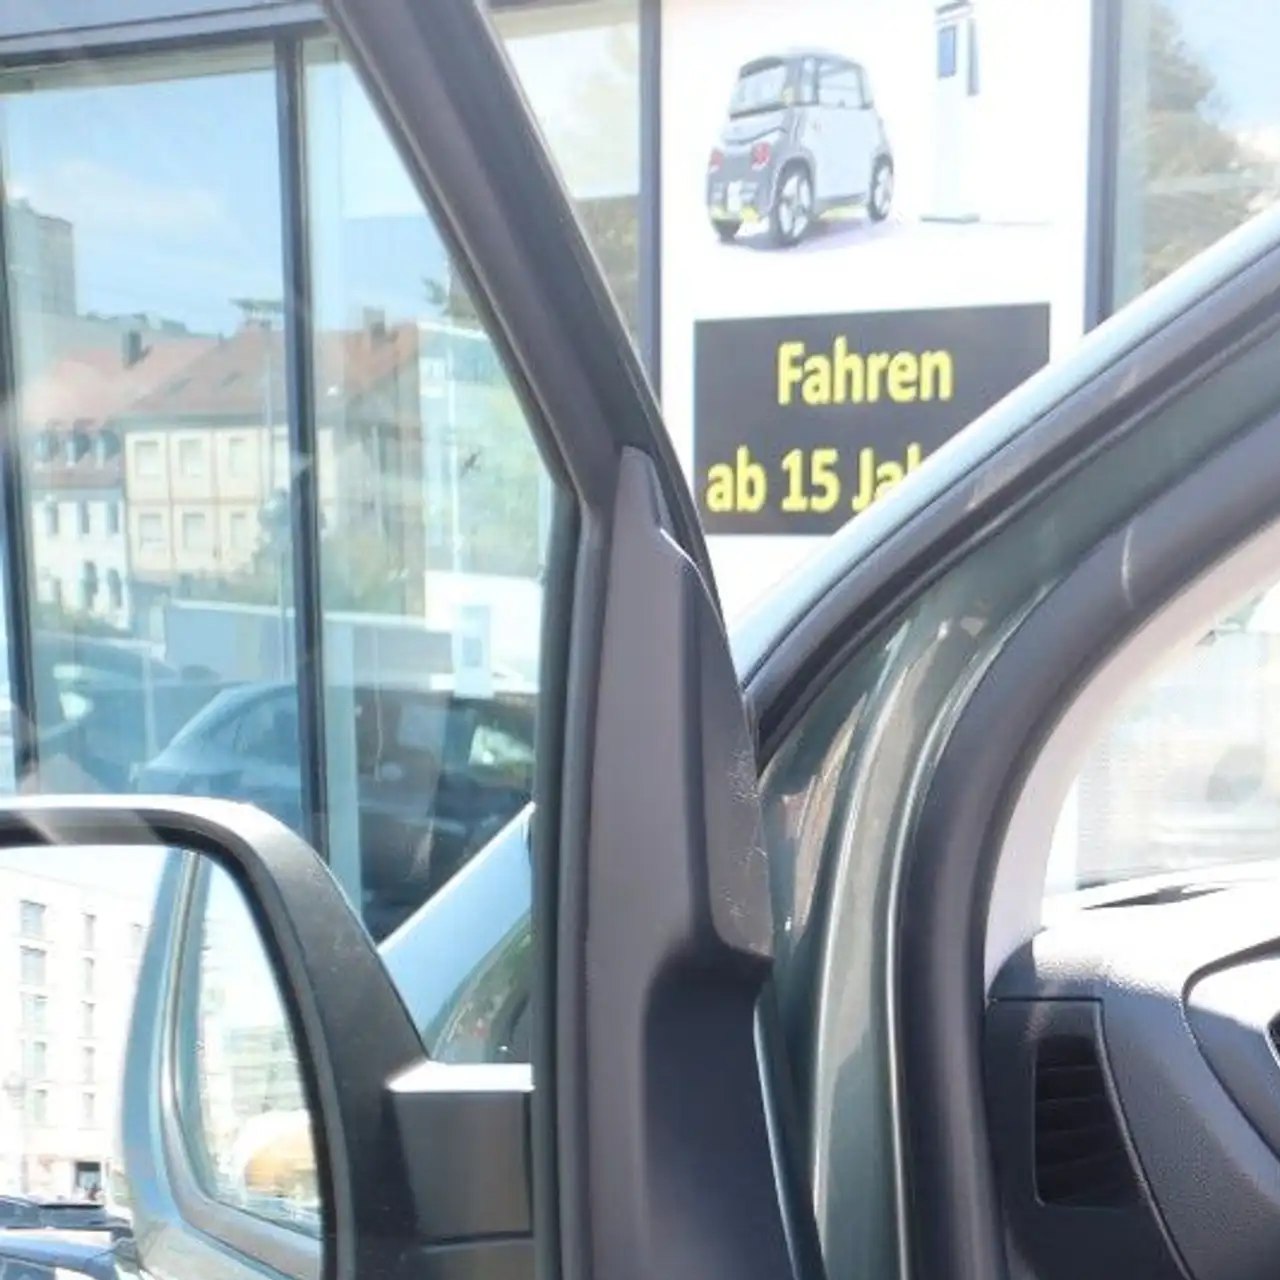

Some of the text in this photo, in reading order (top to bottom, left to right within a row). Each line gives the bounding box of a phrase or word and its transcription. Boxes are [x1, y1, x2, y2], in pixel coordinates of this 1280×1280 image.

[777, 335, 953, 405] Fahren
[705, 444, 768, 513] ab
[781, 447, 841, 513] 15
